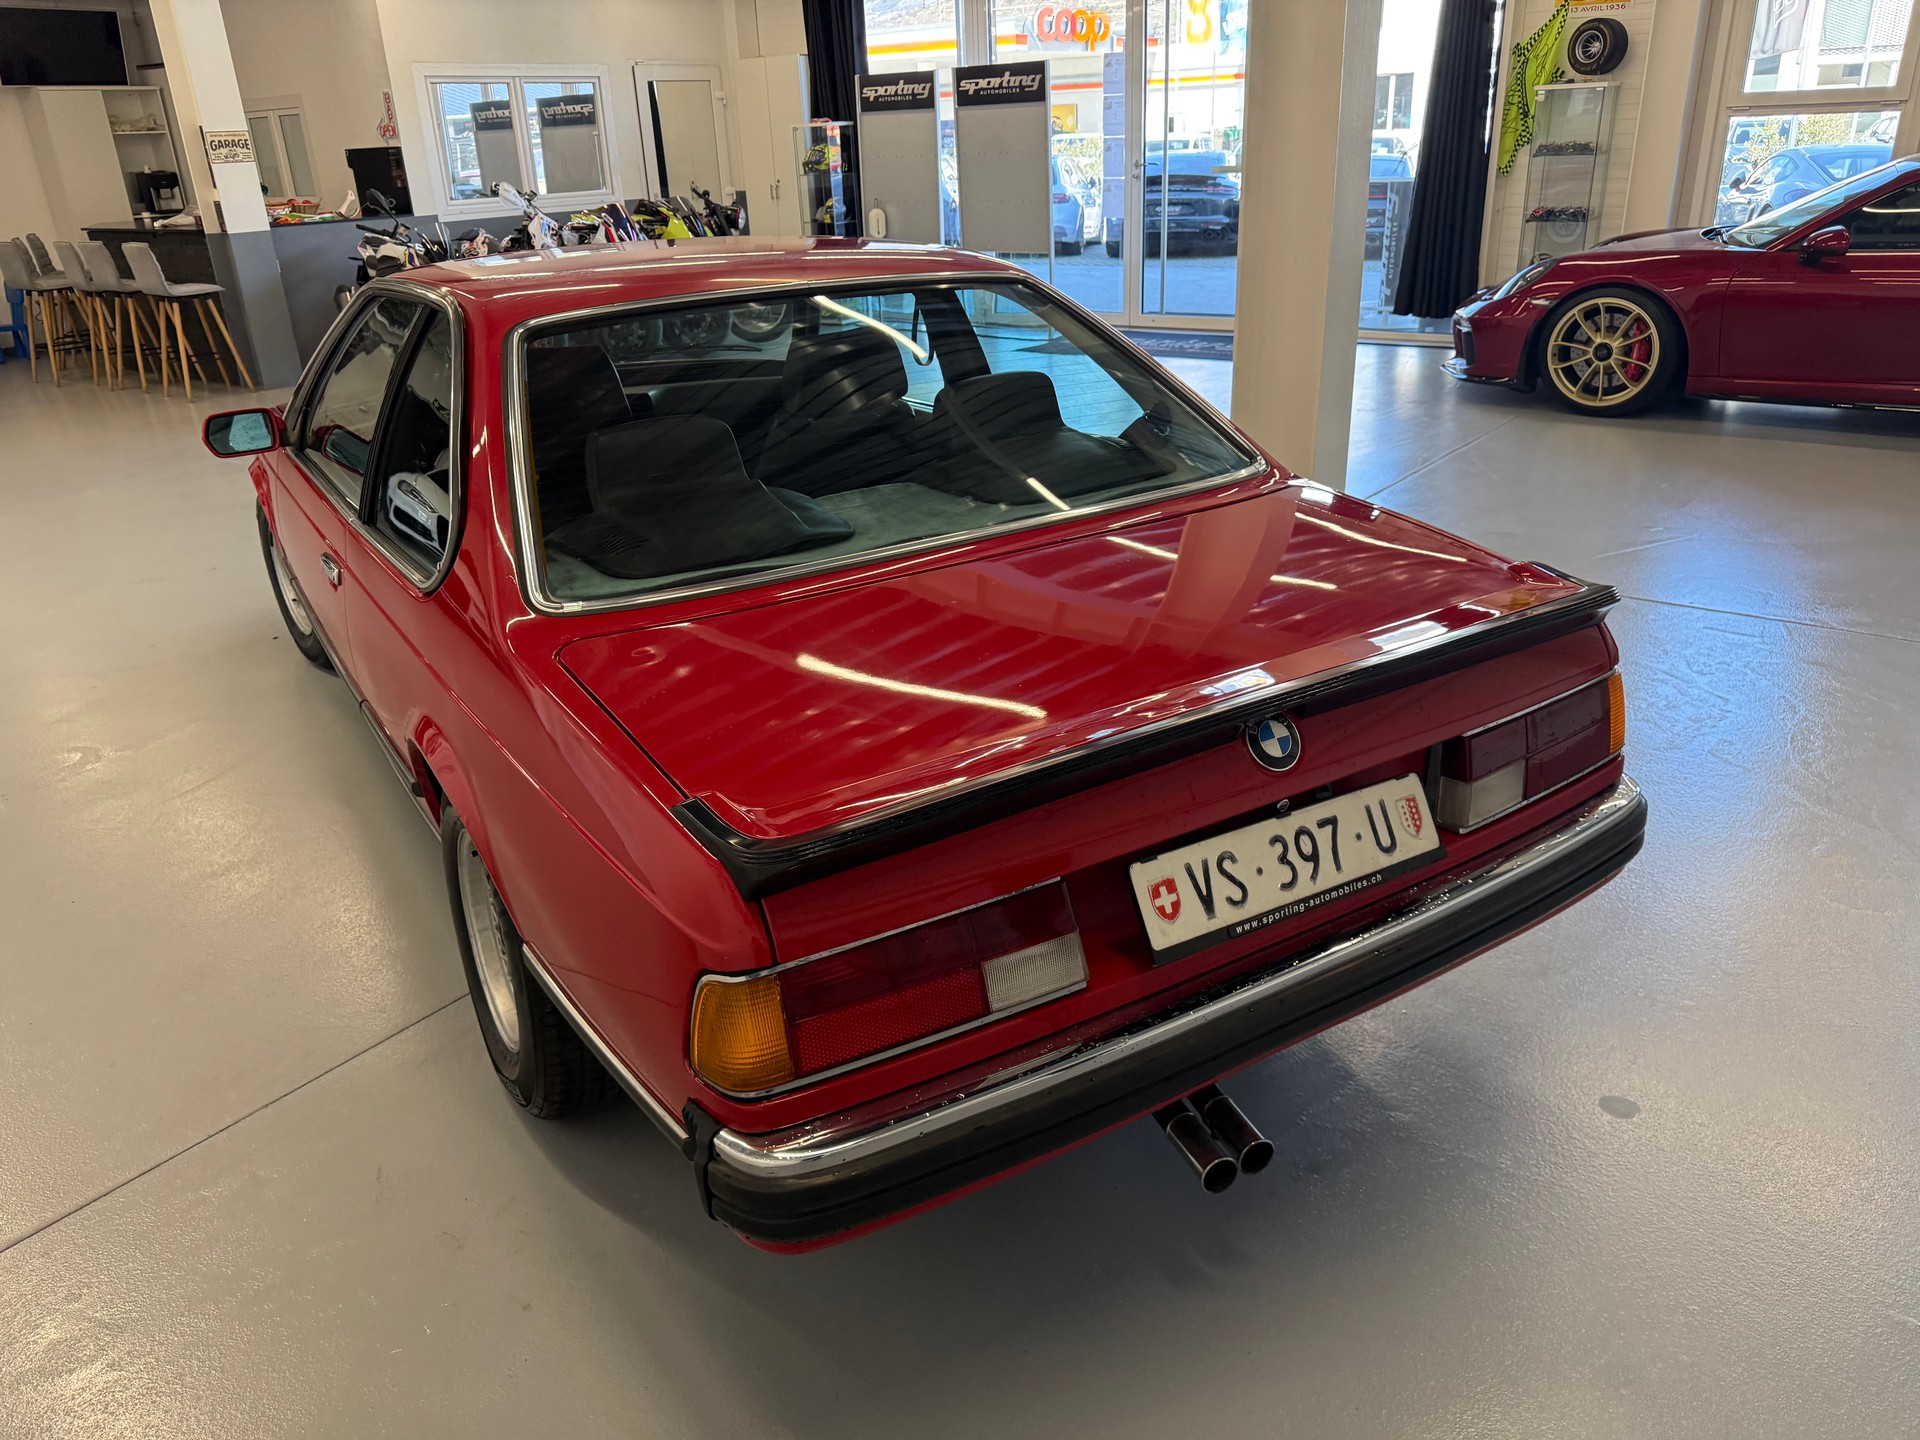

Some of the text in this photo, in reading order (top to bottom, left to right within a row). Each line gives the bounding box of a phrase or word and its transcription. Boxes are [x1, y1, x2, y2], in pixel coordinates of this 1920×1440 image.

[1580, 5, 1604, 13] AVRIL
[862, 80, 932, 101] sporting
[958, 71, 1043, 95] sporting
[210, 138, 251, 151] GARAGE
[1236, 874, 1382, 934] www.sporting-automobiles.ch
